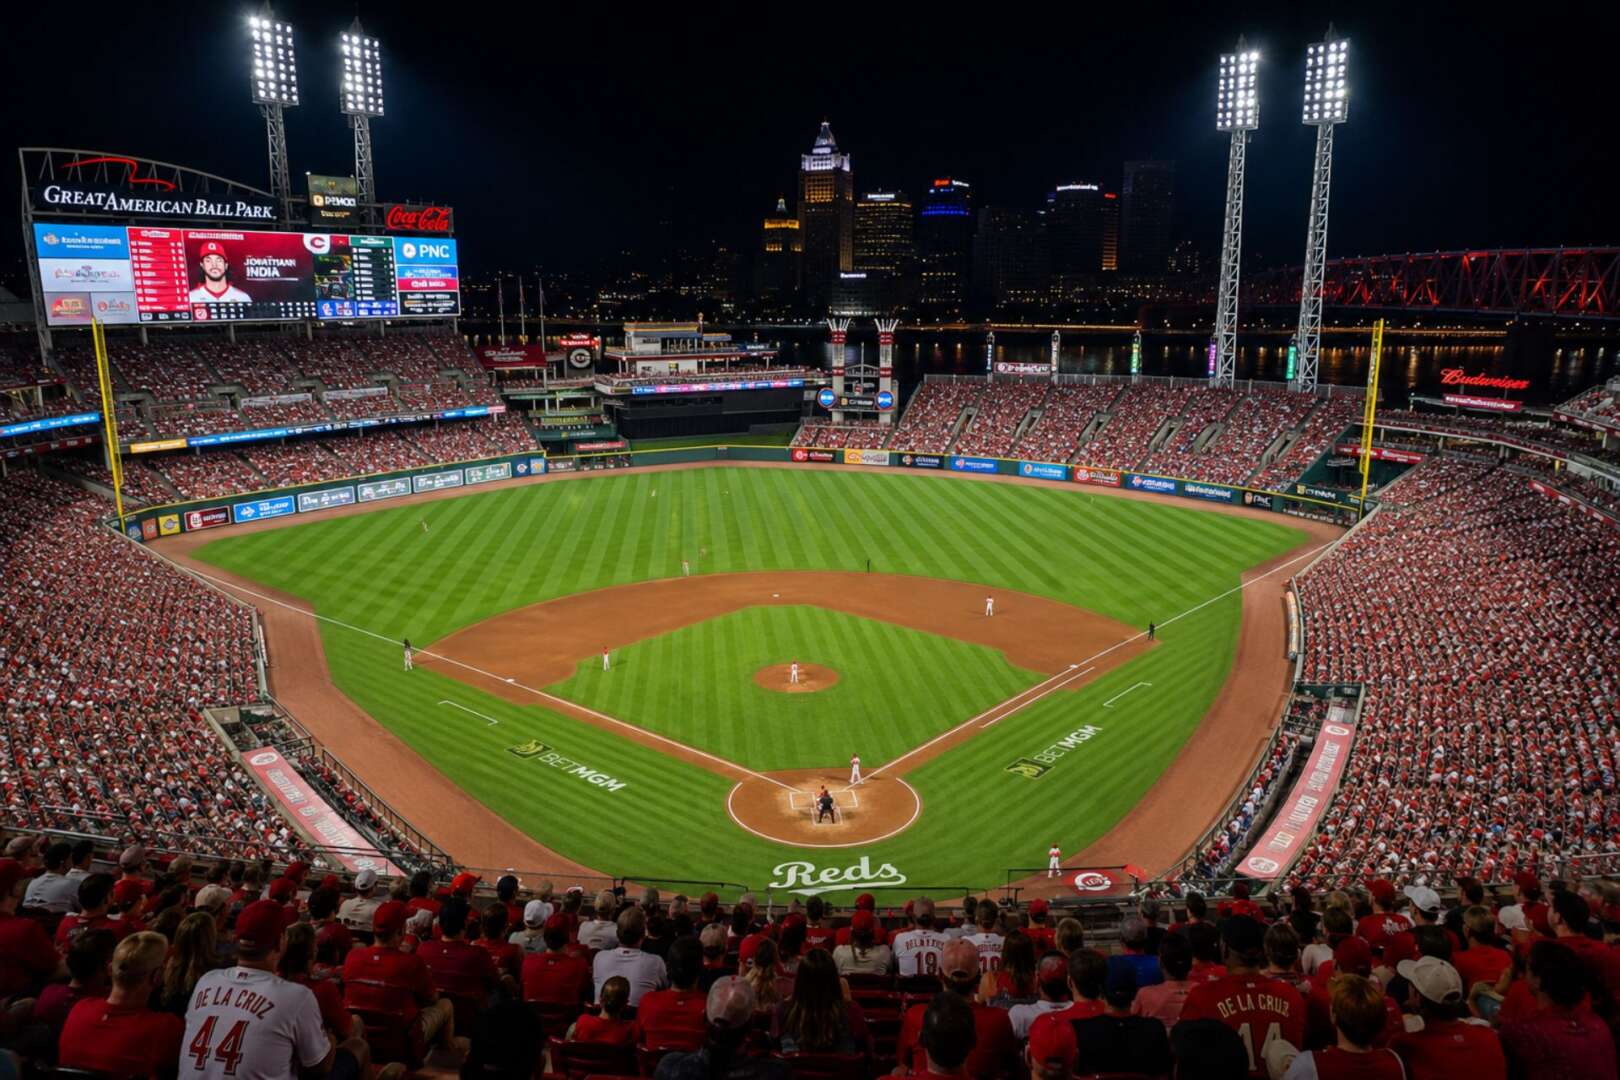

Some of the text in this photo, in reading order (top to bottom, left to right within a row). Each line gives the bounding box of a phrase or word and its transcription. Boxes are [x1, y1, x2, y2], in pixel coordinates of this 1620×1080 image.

[43, 185, 105, 205] GREAT
[103, 192, 193, 215] AMERICAN
[194, 199, 234, 217] BALL
[419, 245, 450, 258] PNC
[246, 266, 280, 277] INDIA
[1440, 368, 1529, 389] Budweiser
[769, 855, 907, 896] Reds
[195, 986, 275, 1020] DE LA CRUZ
[1217, 997, 1237, 1018] DE
[1237, 994, 1256, 1011] LA
[189, 1016, 250, 1075] 44
